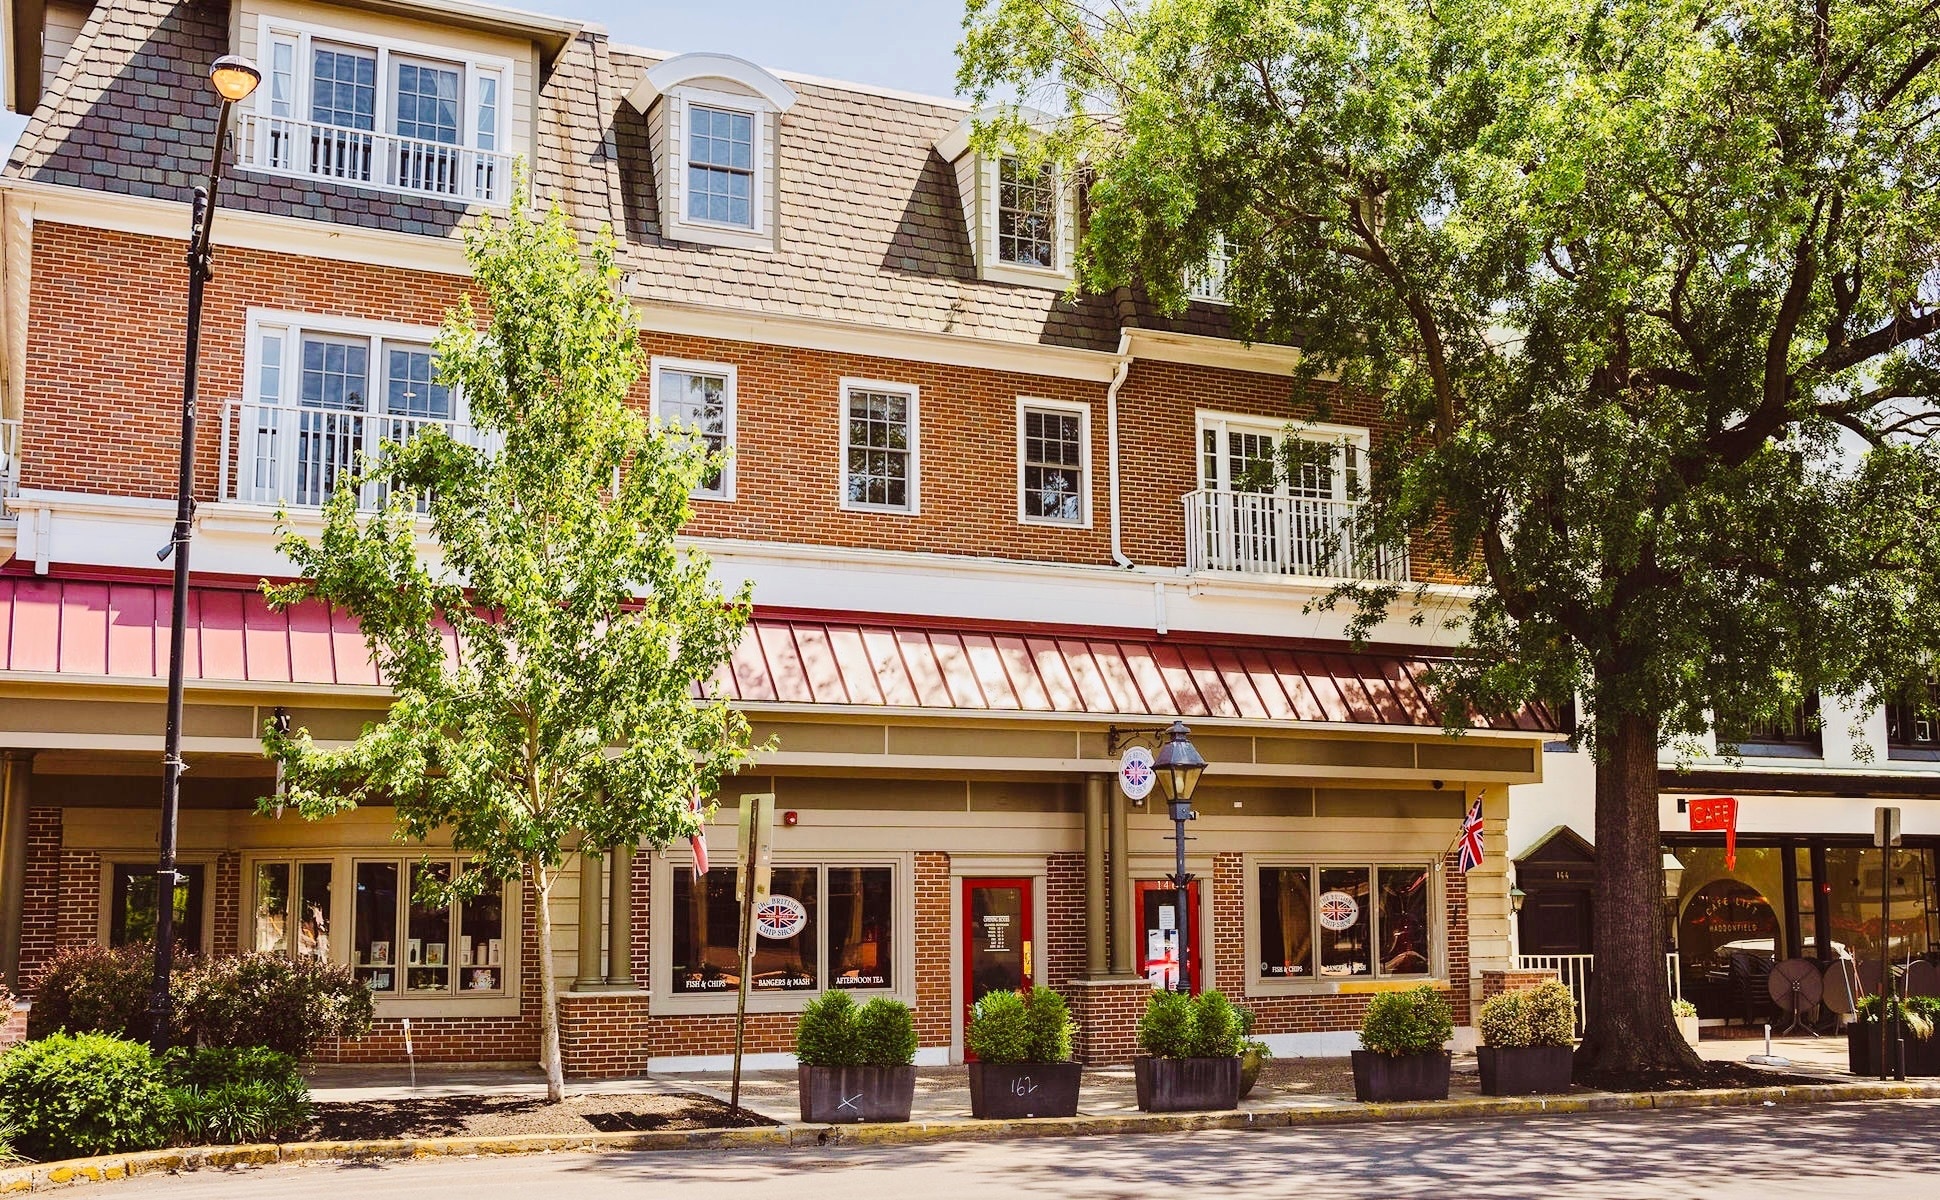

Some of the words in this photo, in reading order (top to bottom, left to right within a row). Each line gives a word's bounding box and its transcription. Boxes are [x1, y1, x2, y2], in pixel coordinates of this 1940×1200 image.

[771, 897, 799, 911] BRITISH
[760, 924, 777, 936] CHIP
[777, 925, 796, 937] SHOP
[686, 980, 701, 988] FISH
[701, 980, 707, 989] &
[707, 979, 726, 988] CHIPS
[758, 979, 786, 987] BANGERS
[786, 979, 792, 987] &
[793, 978, 811, 986] MASH
[836, 976, 872, 984] AFTERNOON
[873, 976, 884, 984] TEA
[1011, 1076, 1039, 1096] 162
